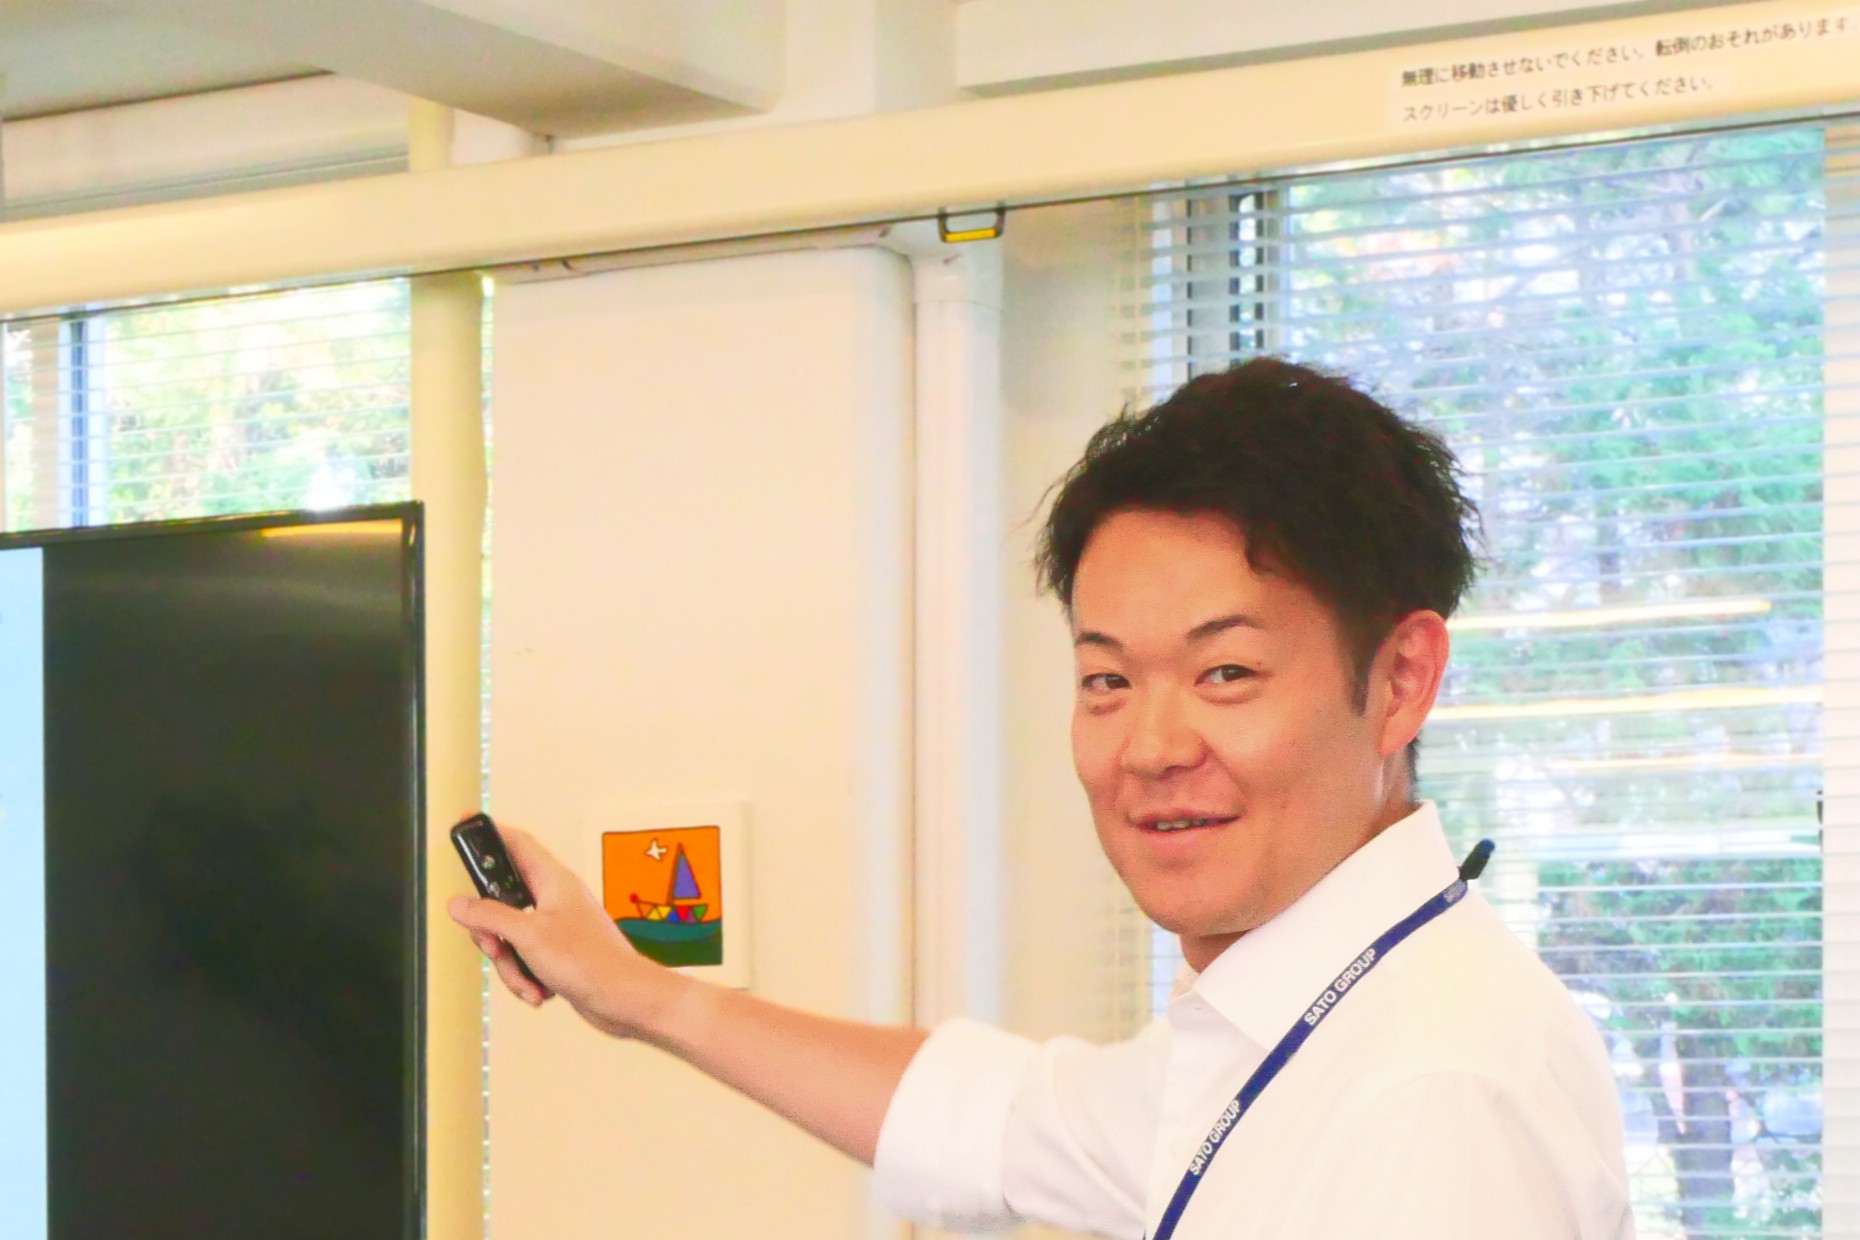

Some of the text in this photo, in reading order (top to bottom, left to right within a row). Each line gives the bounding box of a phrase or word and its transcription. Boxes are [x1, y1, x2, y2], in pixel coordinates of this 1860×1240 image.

[1303, 947, 1376, 1026] SATO GROUP
[1189, 1099, 1240, 1176] SATO GROUP
